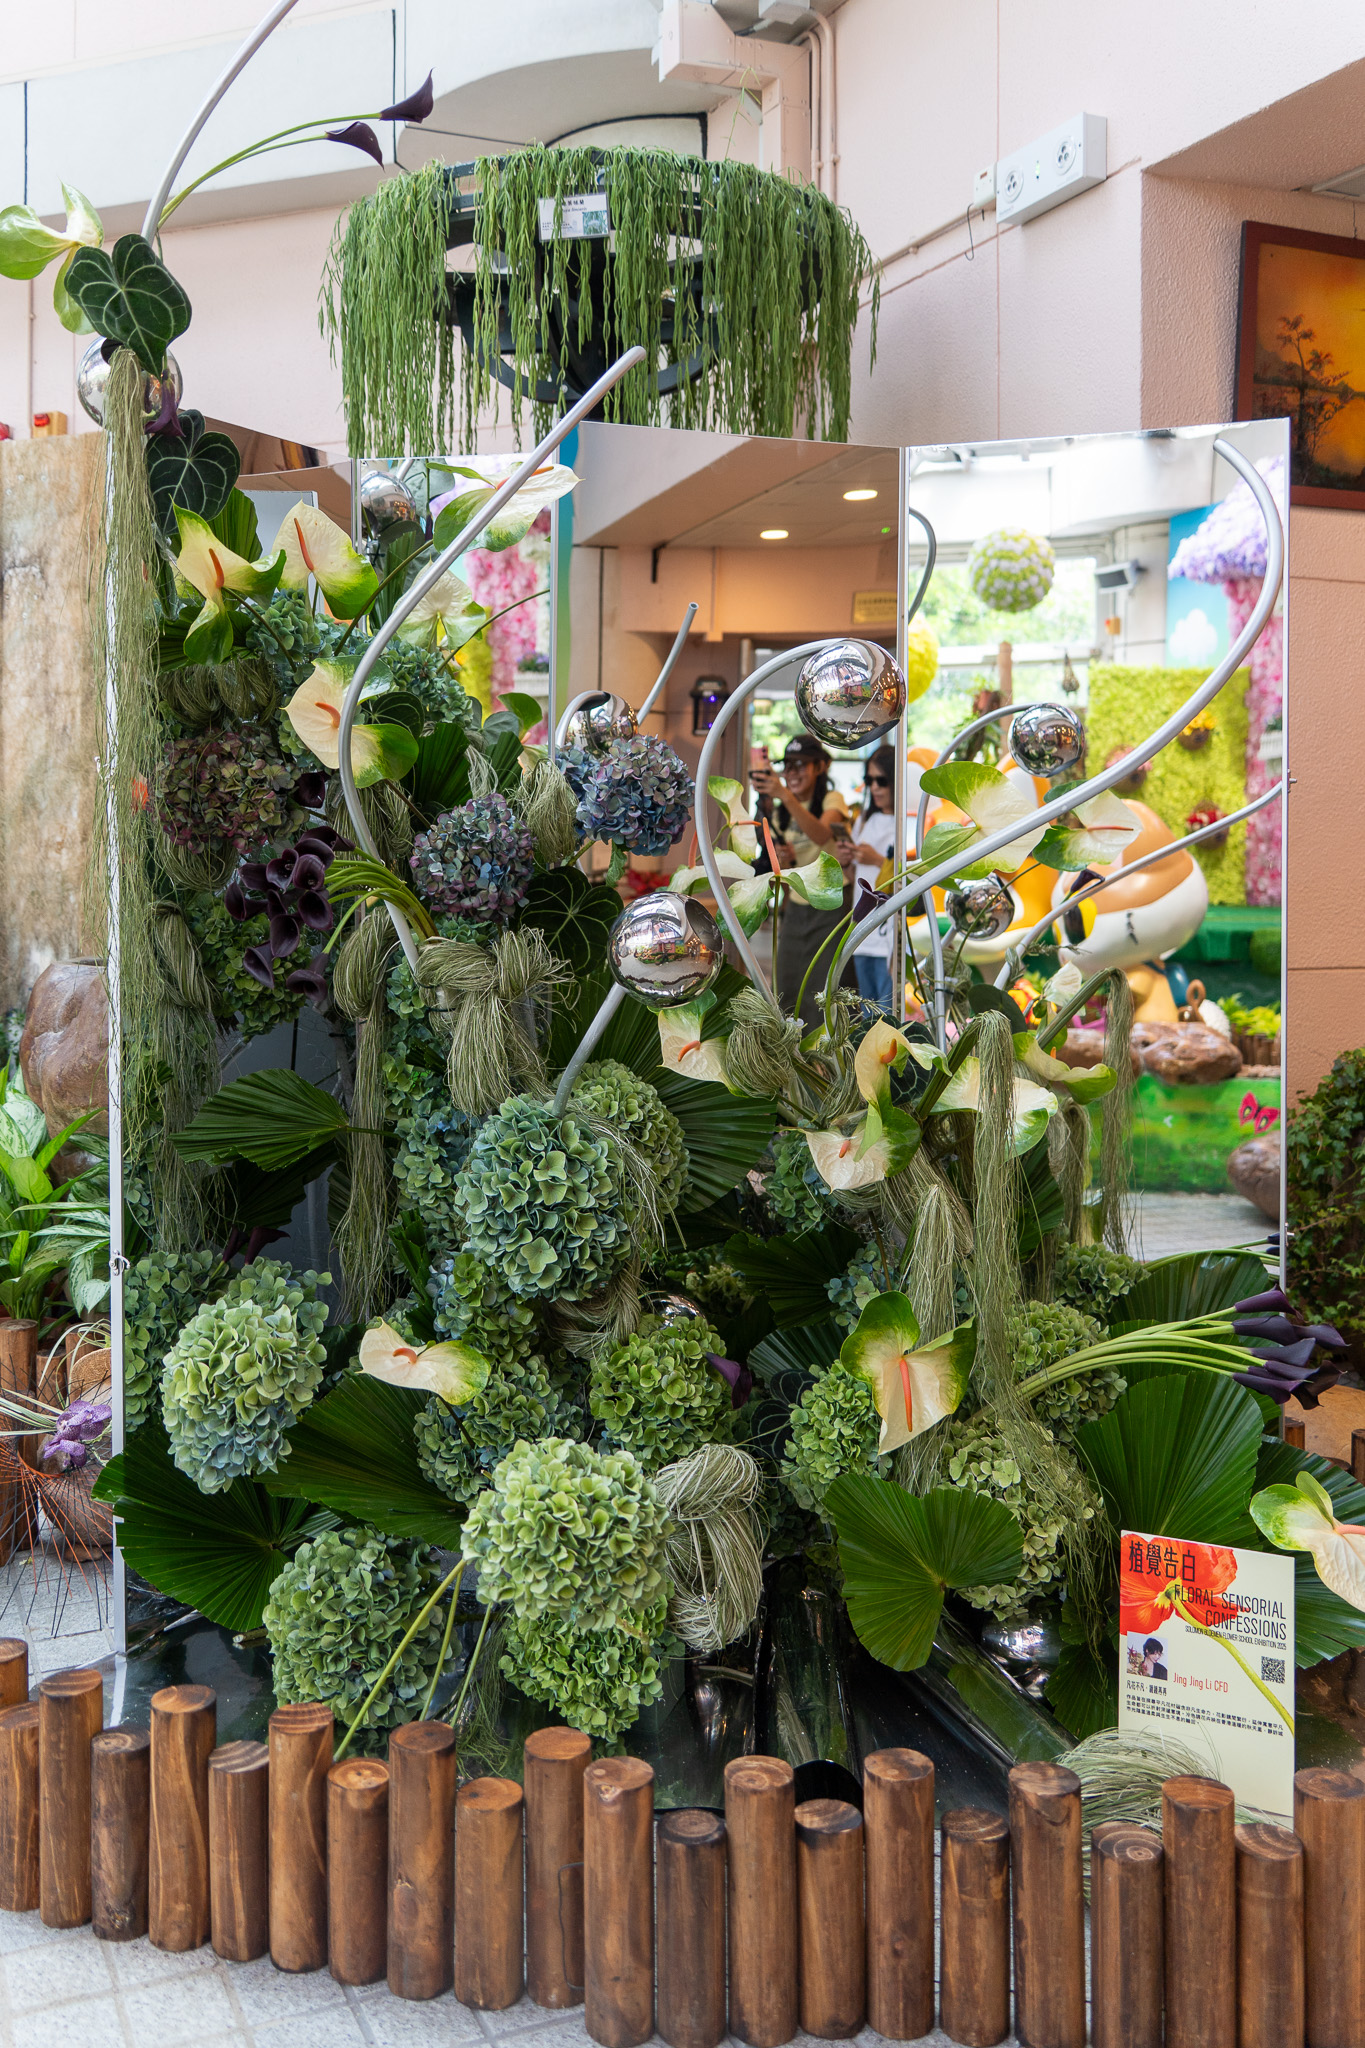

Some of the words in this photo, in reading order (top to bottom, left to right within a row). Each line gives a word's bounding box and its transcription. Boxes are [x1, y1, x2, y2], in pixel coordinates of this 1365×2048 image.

[1129, 1540, 1195, 1582] 植覺告白
[1174, 1584, 1217, 1608] FLORAL
[1221, 1592, 1287, 1619] SENSORIAL
[1185, 1625, 1204, 1634] SOLOMON
[1223, 1632, 1238, 1641] FLOWER
[1238, 1635, 1253, 1645] SCHOOL
[1254, 1638, 1277, 1649] EXHIBITION
[1205, 1610, 1287, 1640] CONFESSIONS
[1173, 1672, 1187, 1687] Jing
[1189, 1675, 1204, 1690] Jing
[1205, 1678, 1212, 1690] Li
[1214, 1680, 1228, 1693] CFD
